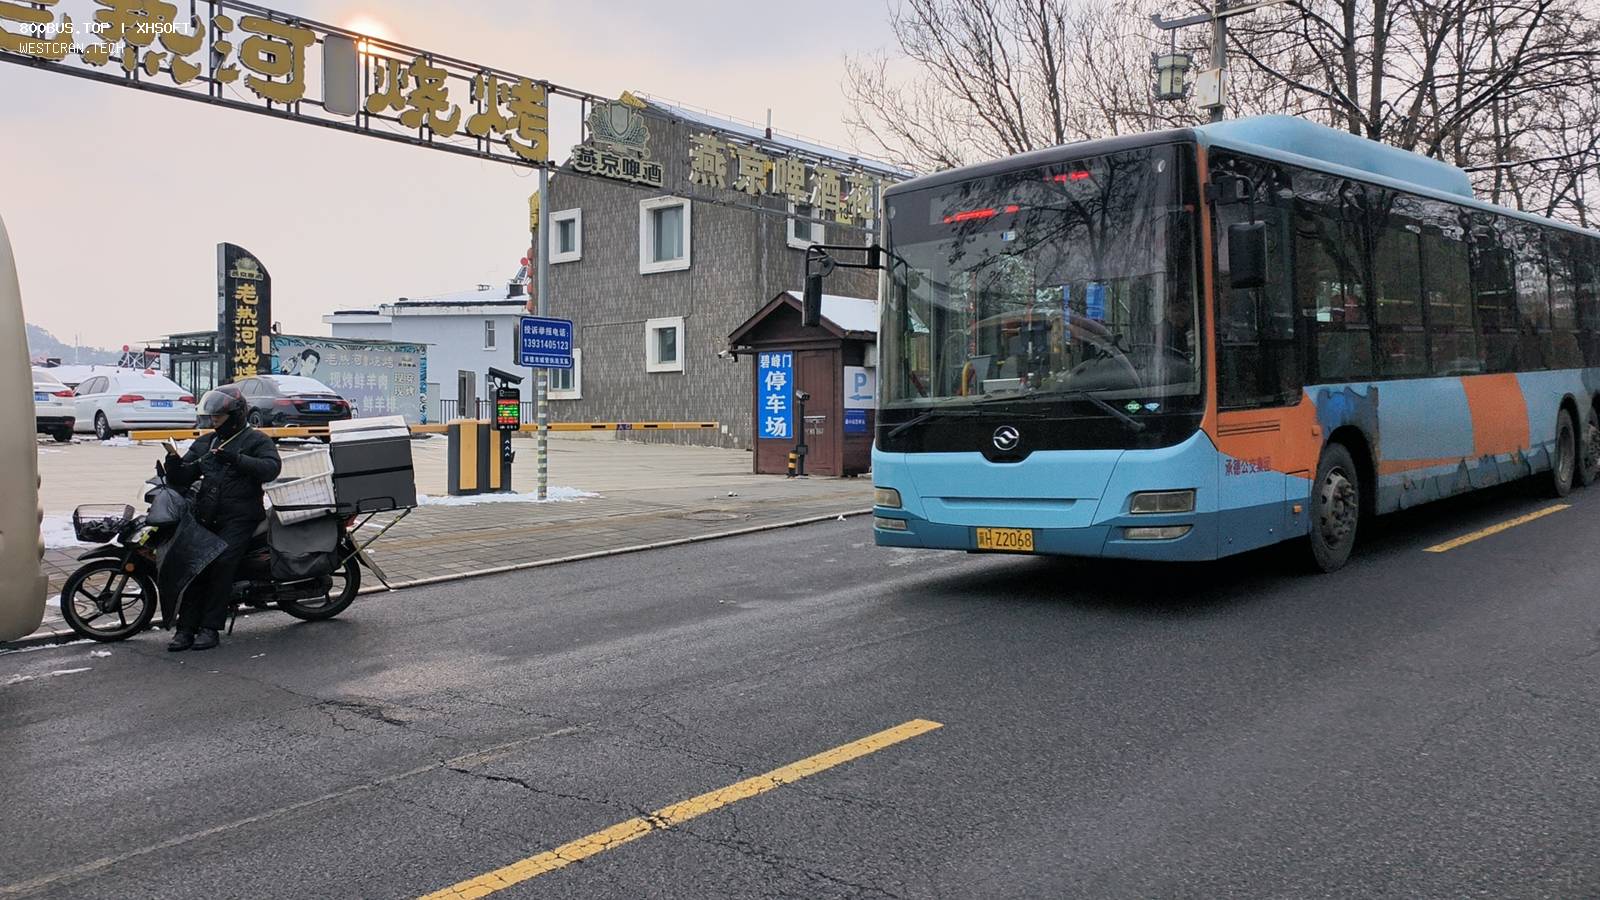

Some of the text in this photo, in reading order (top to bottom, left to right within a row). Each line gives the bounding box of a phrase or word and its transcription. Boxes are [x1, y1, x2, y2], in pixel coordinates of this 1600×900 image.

[365, 55, 548, 163] 烧烤
[572, 146, 663, 185] 燕京啤酒
[523, 338, 568, 350] 13931405123
[760, 354, 791, 368] 碧峰门
[855, 373, 867, 393] P
[765, 370, 787, 437] 停车场
[995, 531, 1032, 548] Z2068
